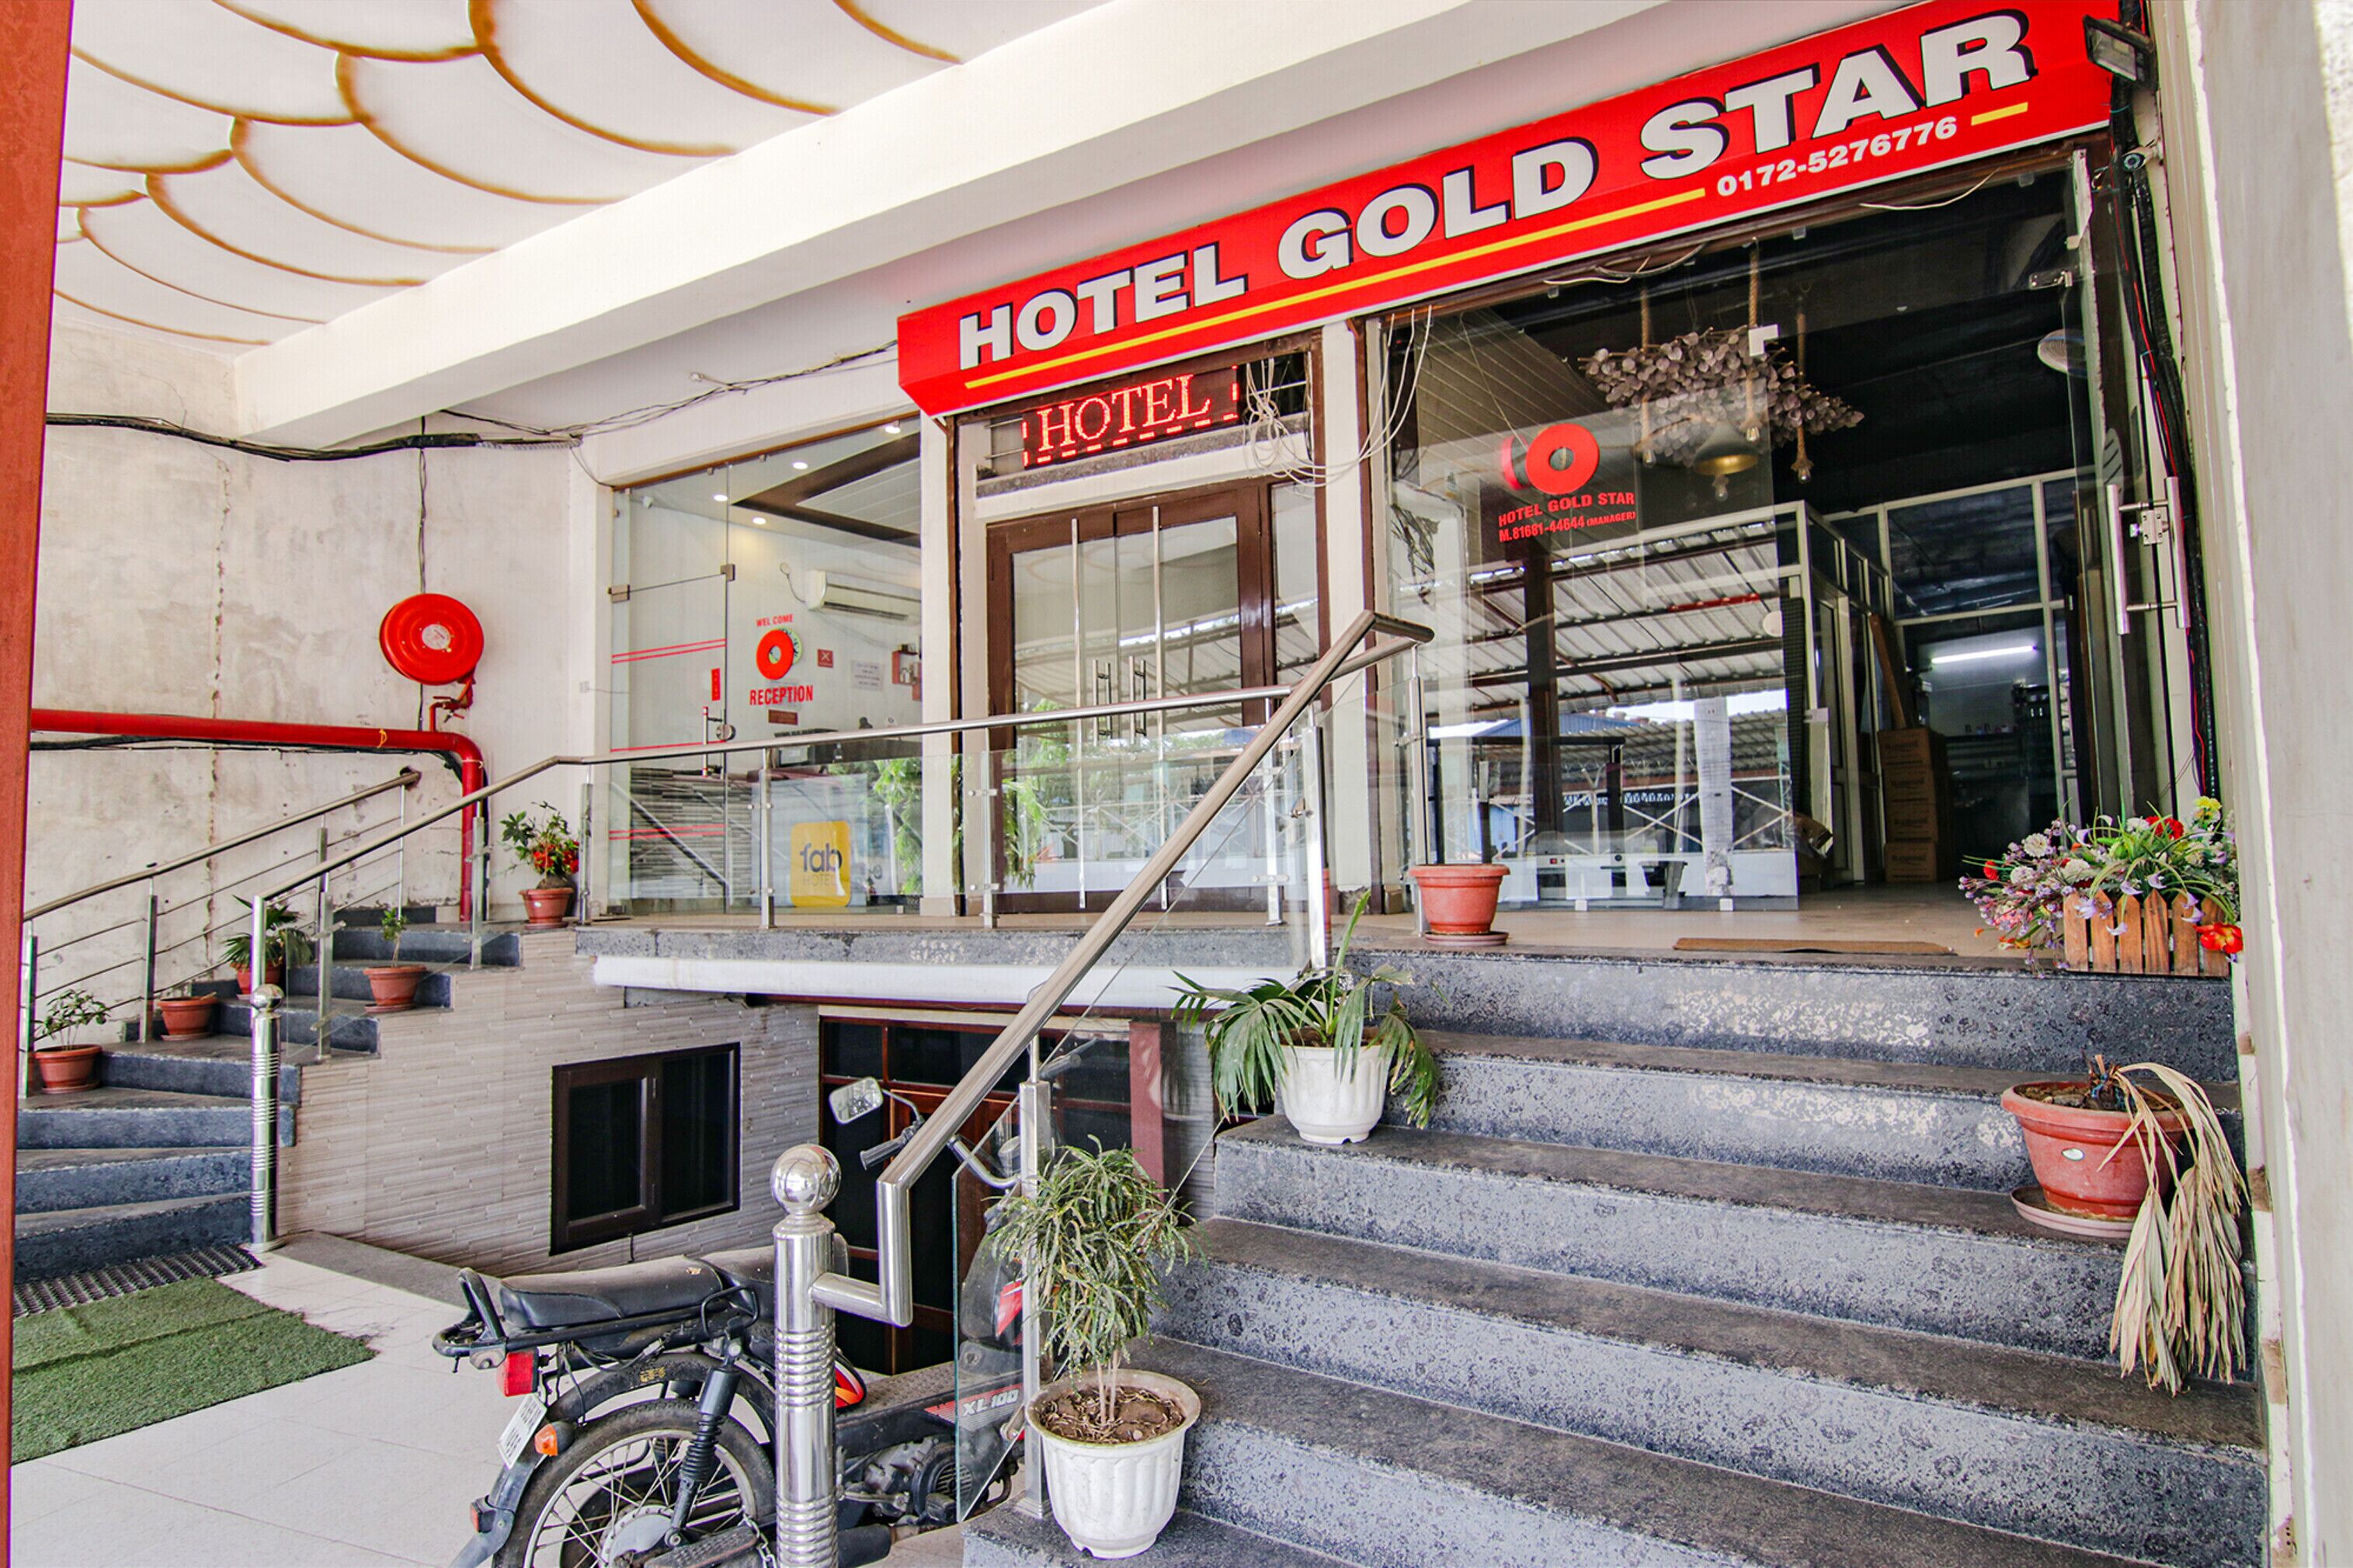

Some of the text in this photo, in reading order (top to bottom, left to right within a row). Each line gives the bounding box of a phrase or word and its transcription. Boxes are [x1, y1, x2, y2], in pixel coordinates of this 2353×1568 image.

[1717, 116, 1957, 196] 0172-5276776
[960, 9, 2036, 370] HOTEL GOLD STAR
[1037, 374, 1210, 452] HOTEL
[1498, 492, 1635, 527] HOTEL GOLD STAR
[1587, 511, 1636, 527] (MANAGER)
[749, 684, 814, 706] RECEPTION
[800, 843, 843, 872] fab
[962, 1389, 1019, 1416] XL 100
